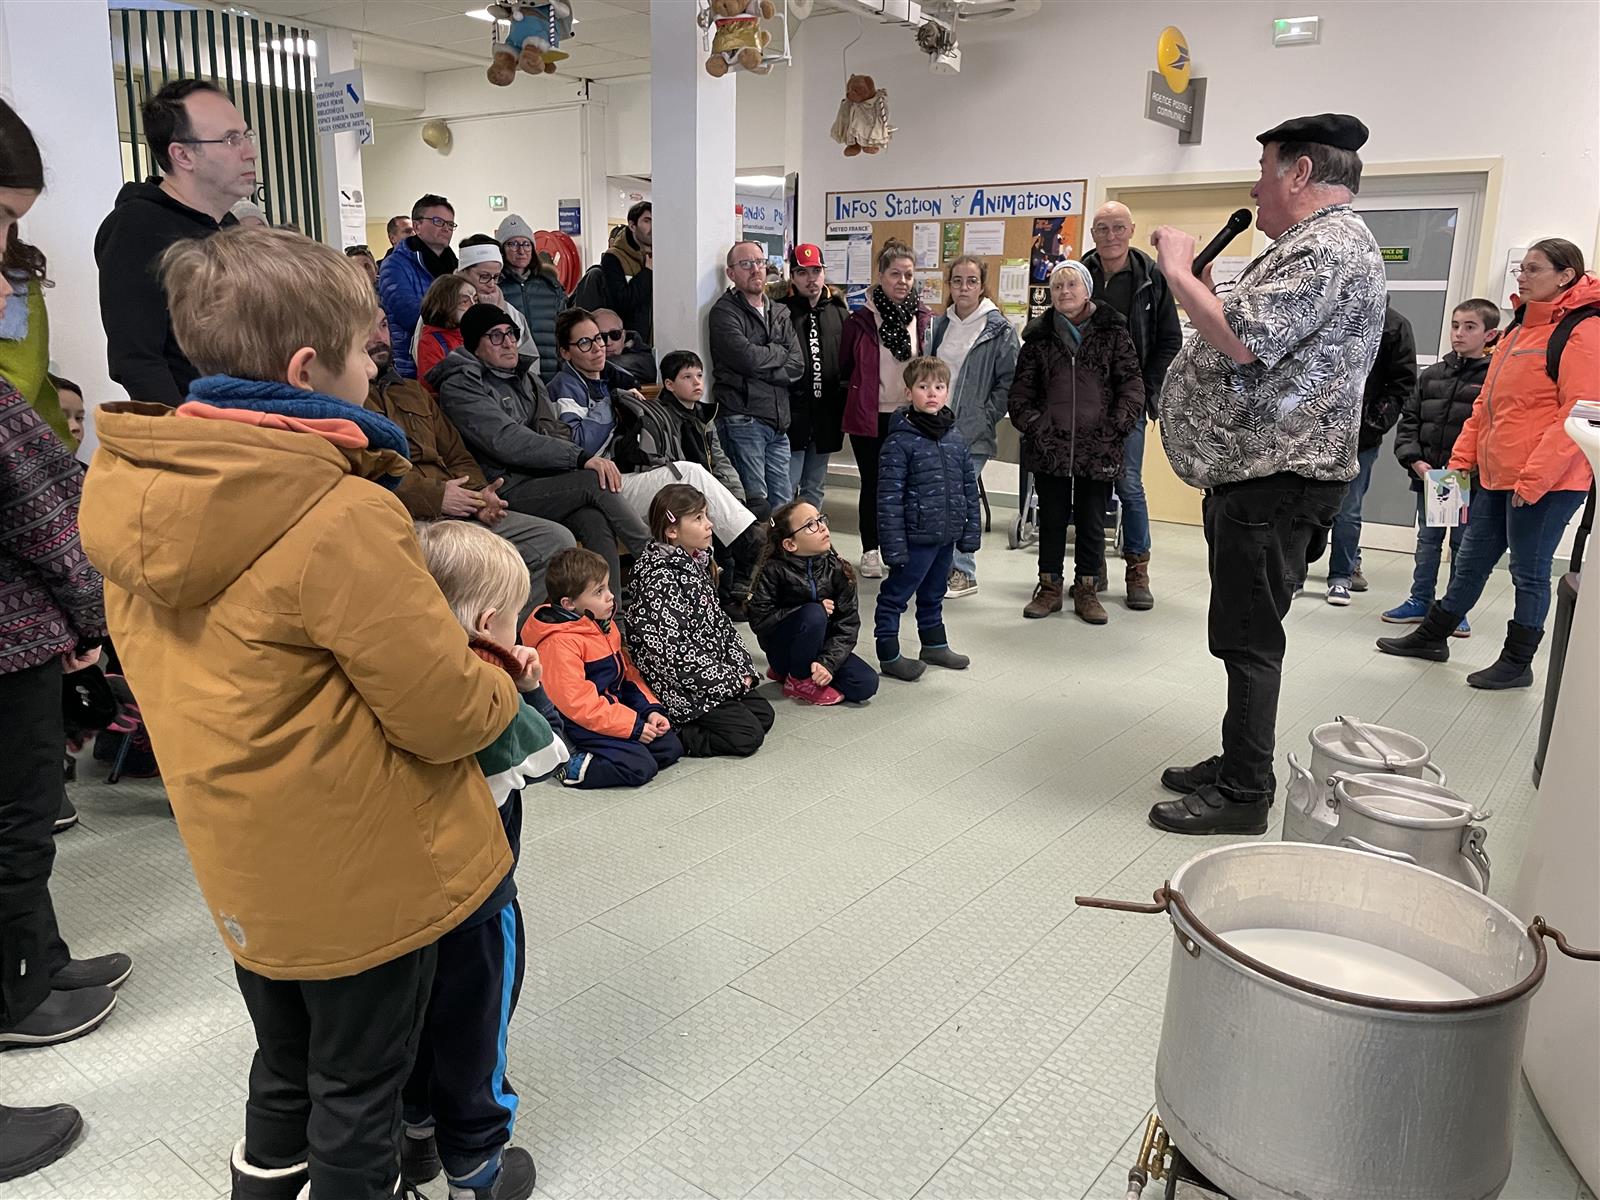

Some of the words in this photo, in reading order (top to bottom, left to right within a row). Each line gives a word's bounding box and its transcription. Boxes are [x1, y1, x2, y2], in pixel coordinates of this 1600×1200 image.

[1151, 91, 1173, 107] AGENCE
[1172, 99, 1193, 114] POSTALE
[1156, 106, 1187, 124] COMMUNALE
